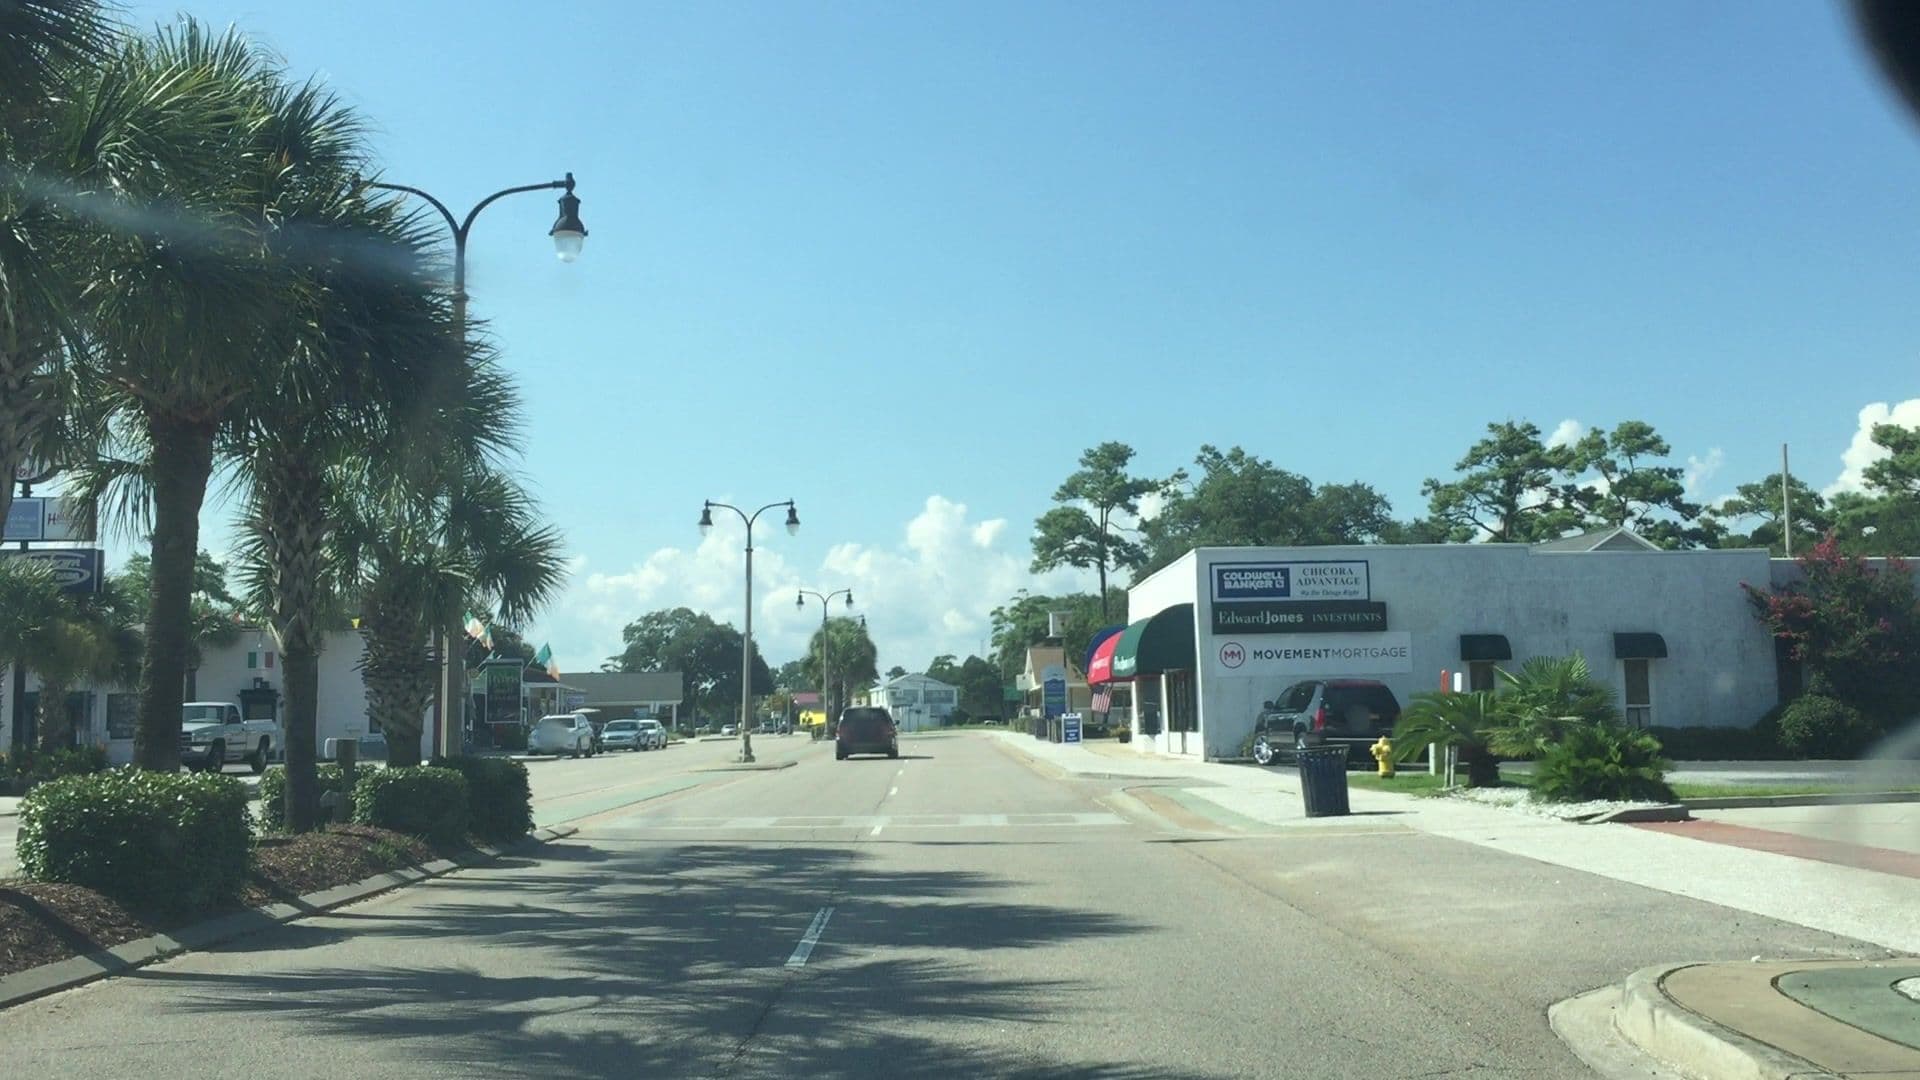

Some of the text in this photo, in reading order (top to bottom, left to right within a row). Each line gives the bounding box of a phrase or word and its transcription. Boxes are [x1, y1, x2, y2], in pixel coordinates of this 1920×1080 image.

[1302, 567, 1354, 576] CHICORA
[1296, 577, 1360, 586] ADVANTAGE
[1312, 613, 1382, 622] INVESTMENTS
